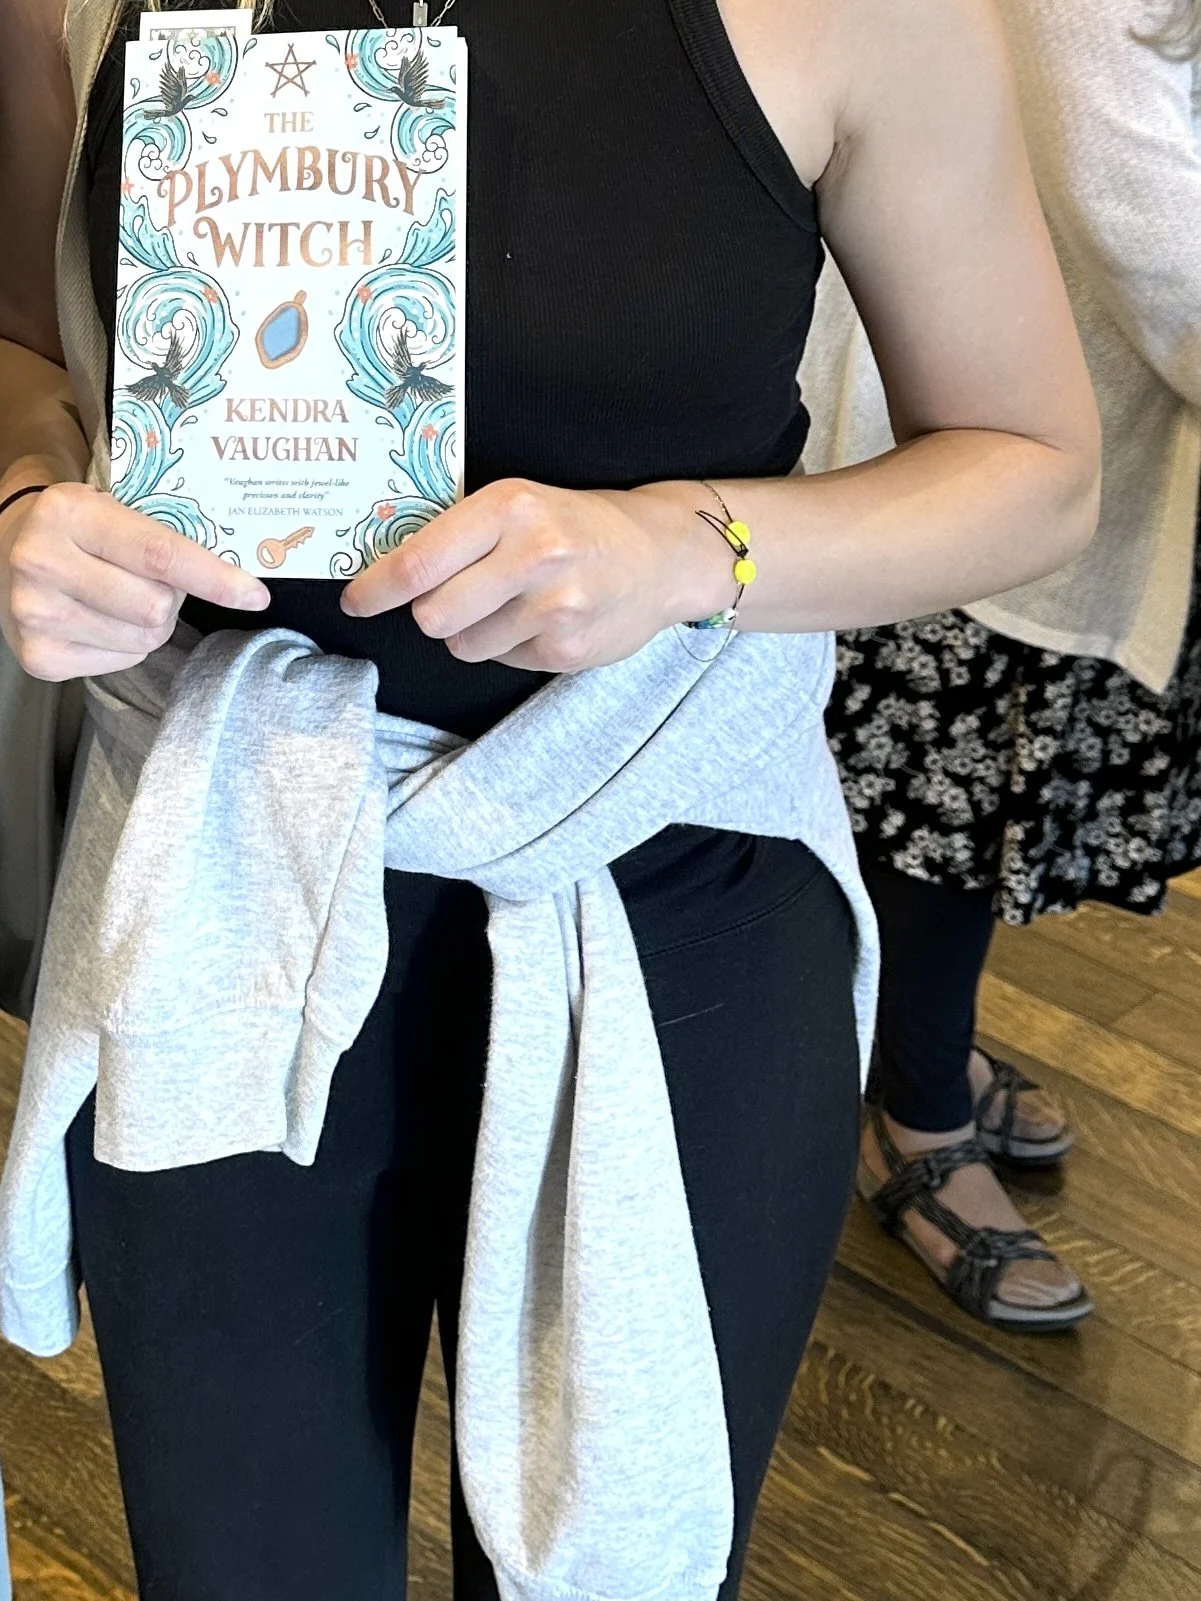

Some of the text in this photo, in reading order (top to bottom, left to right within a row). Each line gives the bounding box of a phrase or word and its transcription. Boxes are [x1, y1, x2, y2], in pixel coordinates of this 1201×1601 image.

[264, 111, 314, 134] THE
[157, 145, 427, 228] PLYMBURY
[193, 216, 374, 268] WITCH
[225, 398, 349, 423] KENDRA
[210, 435, 359, 462] VAUGHAN
[265, 478, 289, 486] writes
[291, 478, 309, 486] with
[310, 478, 350, 488] jewel-like
[281, 490, 296, 499] and
[228, 506, 343, 516] JAN ELIZABETH WATSON
